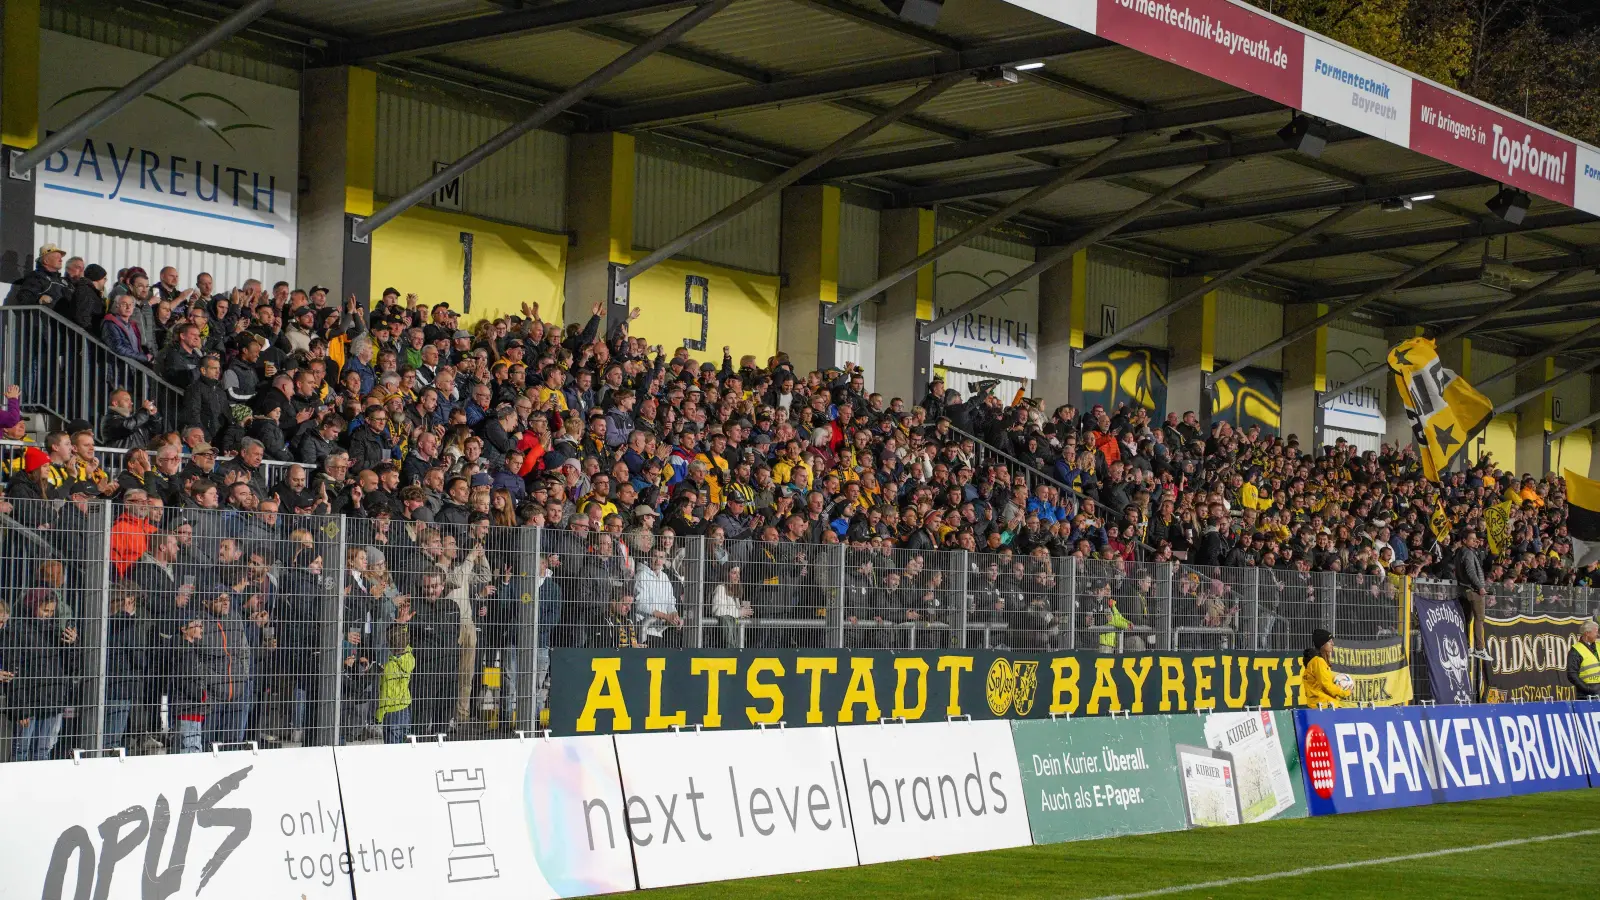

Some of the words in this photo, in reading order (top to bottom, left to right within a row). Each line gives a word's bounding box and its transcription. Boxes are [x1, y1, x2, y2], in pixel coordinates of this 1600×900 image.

[1314, 58, 1391, 99] Formentechnik
[1351, 92, 1397, 121] Bayreuth
[1420, 104, 1436, 127] Wir
[1437, 109, 1477, 142] bringen's
[1478, 126, 1487, 145] in
[1492, 123, 1568, 185] Topform!
[440, 166, 460, 206] M
[459, 231, 475, 314] 1
[685, 275, 709, 352] 9
[1105, 308, 1115, 335] N
[576, 656, 974, 732] ALTSTADT
[1049, 655, 1307, 715] BAYREUTH
[1226, 717, 1258, 746] KURIER
[1032, 753, 1062, 776] Dein
[1062, 751, 1102, 775] Kurier.
[1102, 745, 1149, 772] Überall.
[1195, 763, 1221, 779] KURIER
[1334, 716, 1506, 798] FRANKEN
[582, 775, 713, 852] next
[728, 760, 847, 838] level
[863, 752, 1008, 826] brands
[1041, 787, 1072, 811] Auch
[1074, 785, 1092, 809] als
[1092, 784, 1145, 811] E-Paper.
[41, 764, 254, 900] OPUS
[280, 799, 342, 843] only
[284, 838, 417, 888] together
